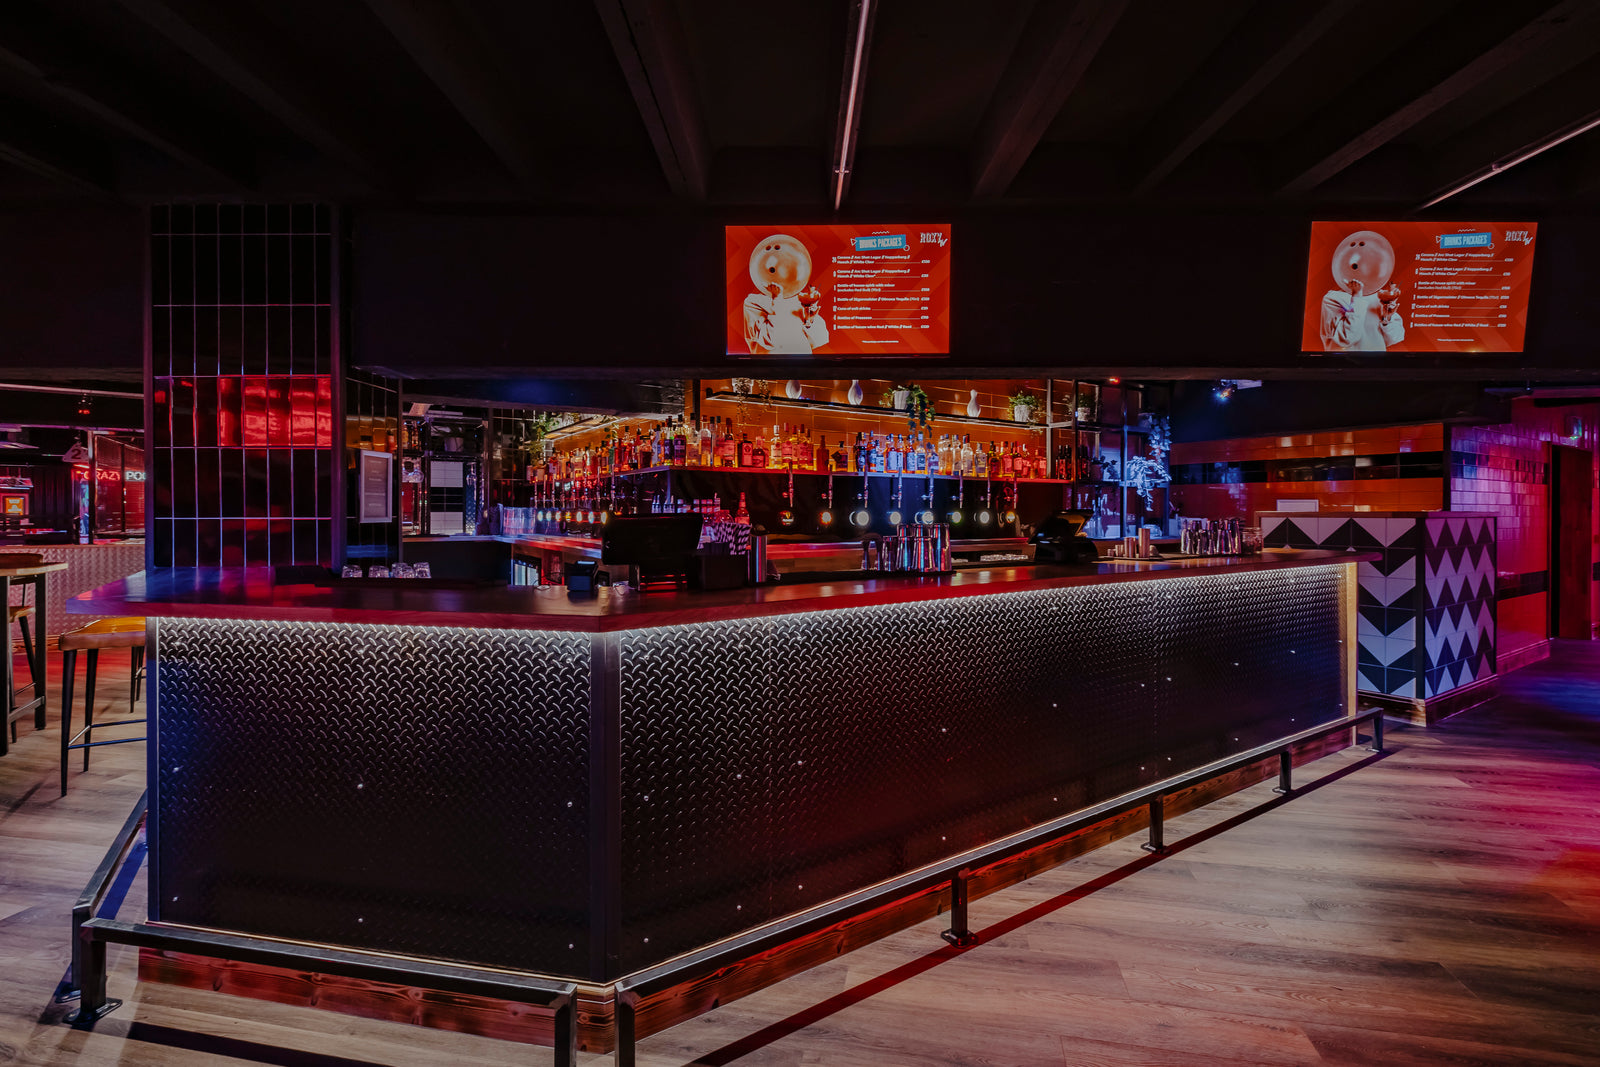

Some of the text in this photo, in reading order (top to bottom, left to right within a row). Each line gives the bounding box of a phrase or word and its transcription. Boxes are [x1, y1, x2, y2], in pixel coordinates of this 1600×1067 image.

[878, 238, 902, 249] PACKAGES
[1462, 235, 1488, 246] PACKAGES
[72, 449, 82, 460] 2
